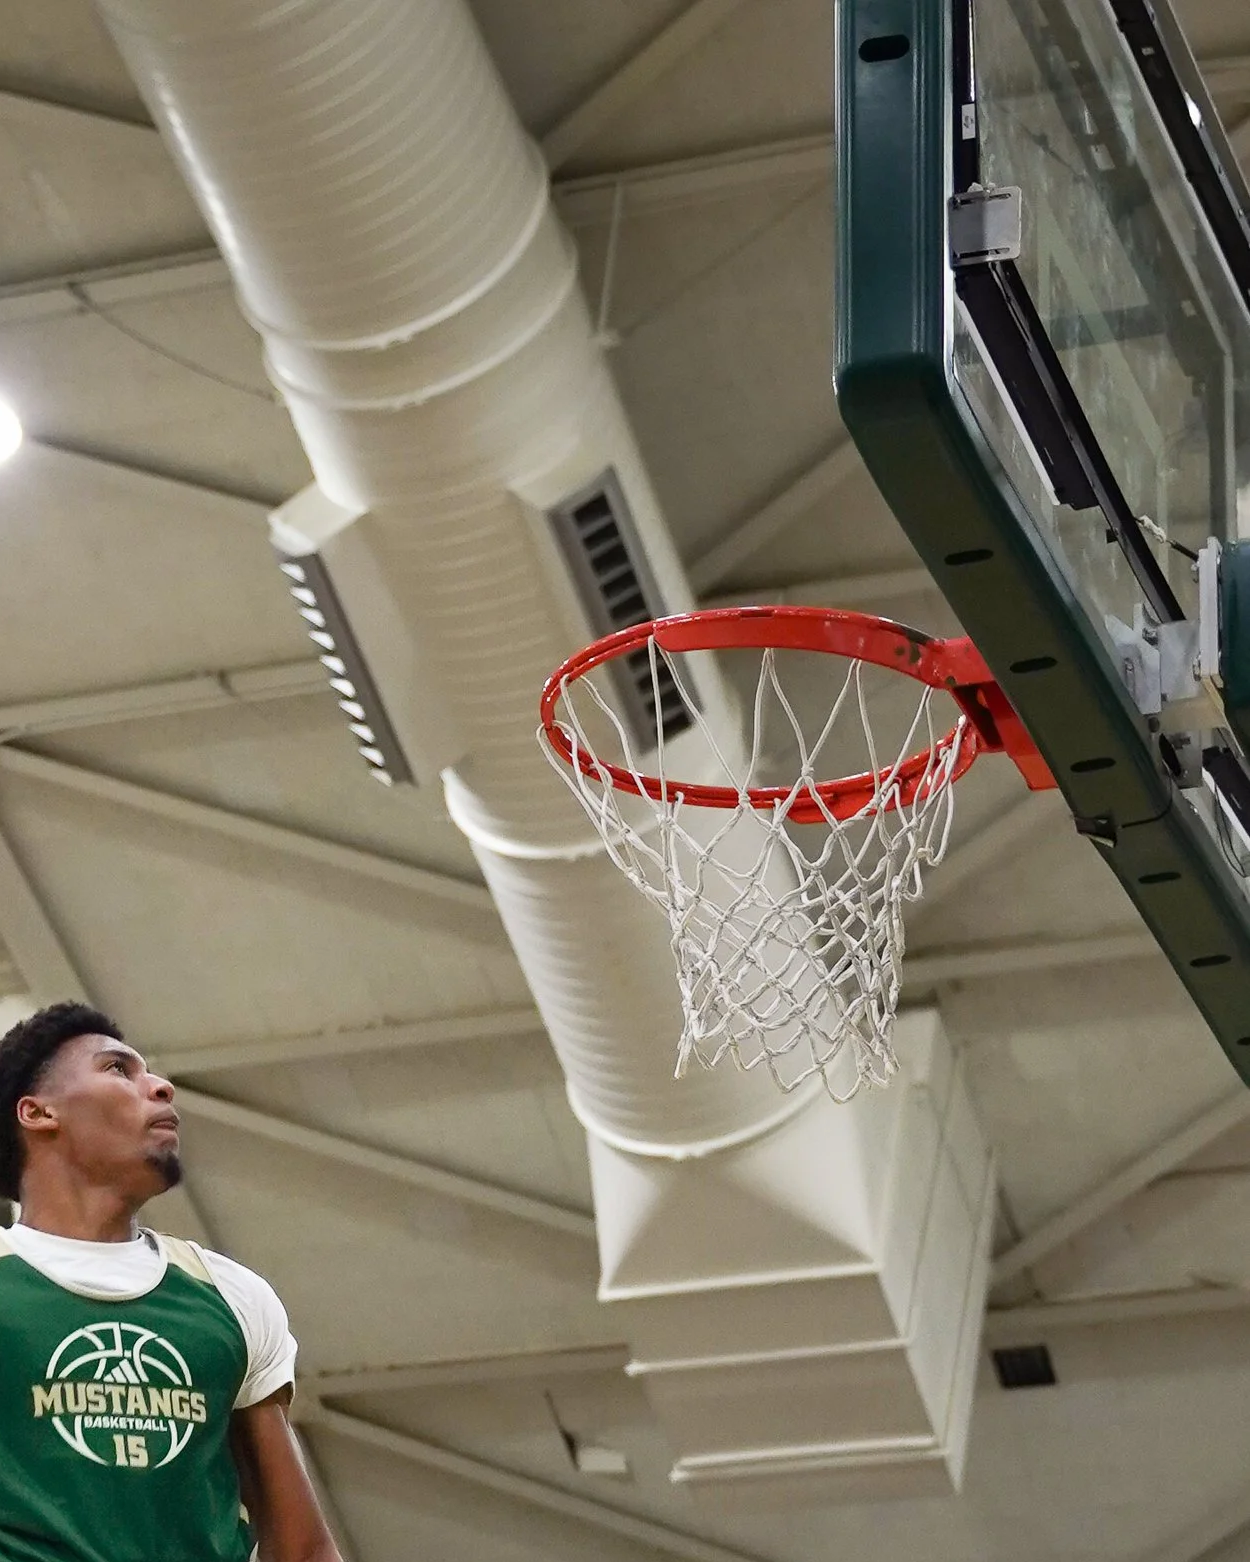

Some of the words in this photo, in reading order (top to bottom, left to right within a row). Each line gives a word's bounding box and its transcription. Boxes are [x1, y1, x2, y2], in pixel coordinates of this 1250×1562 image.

[31, 1381, 207, 1424] MUSTANGS
[83, 1415, 168, 1432] BASKETBALL
[112, 1433, 149, 1468] 15
